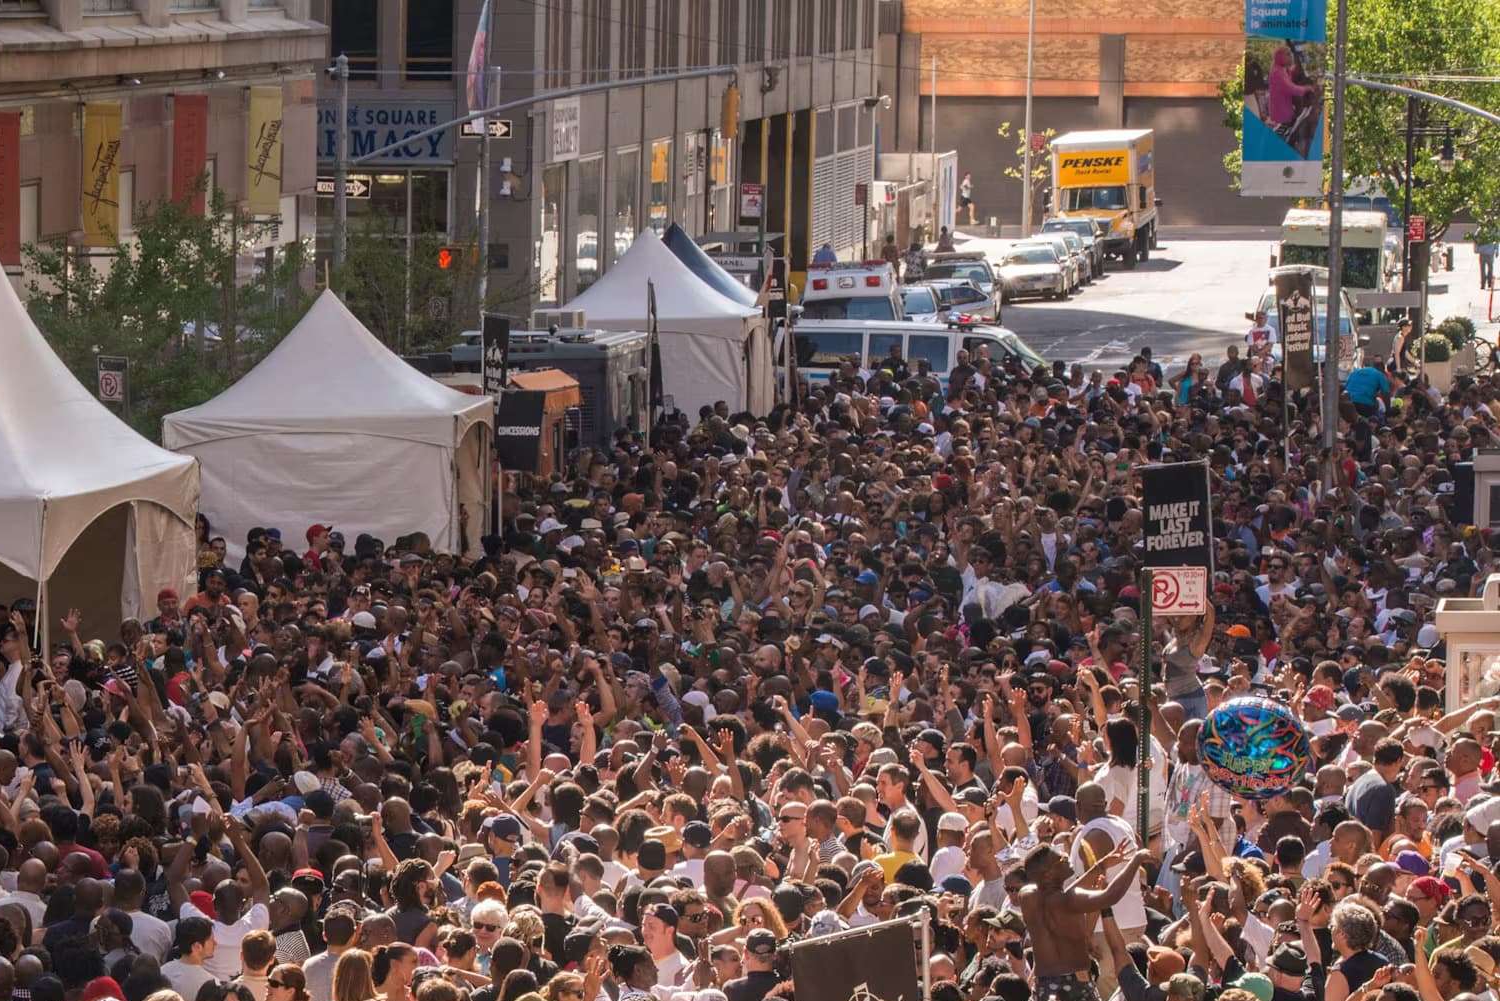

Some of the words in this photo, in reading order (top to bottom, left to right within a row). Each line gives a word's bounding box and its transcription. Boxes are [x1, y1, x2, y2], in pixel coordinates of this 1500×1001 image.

[1252, 8, 1288, 18] Square
[1261, 18, 1308, 28] animated
[366, 110, 437, 125] SQUARE
[1062, 156, 1124, 168] PENSKE
[498, 426, 540, 436] CONCESSIONS
[1149, 502, 1188, 521] MAKE
[1189, 501, 1200, 517] IT
[1160, 517, 1191, 535] LAST
[1147, 531, 1204, 551] FOREVER
[1222, 752, 1274, 774] HAPPY
